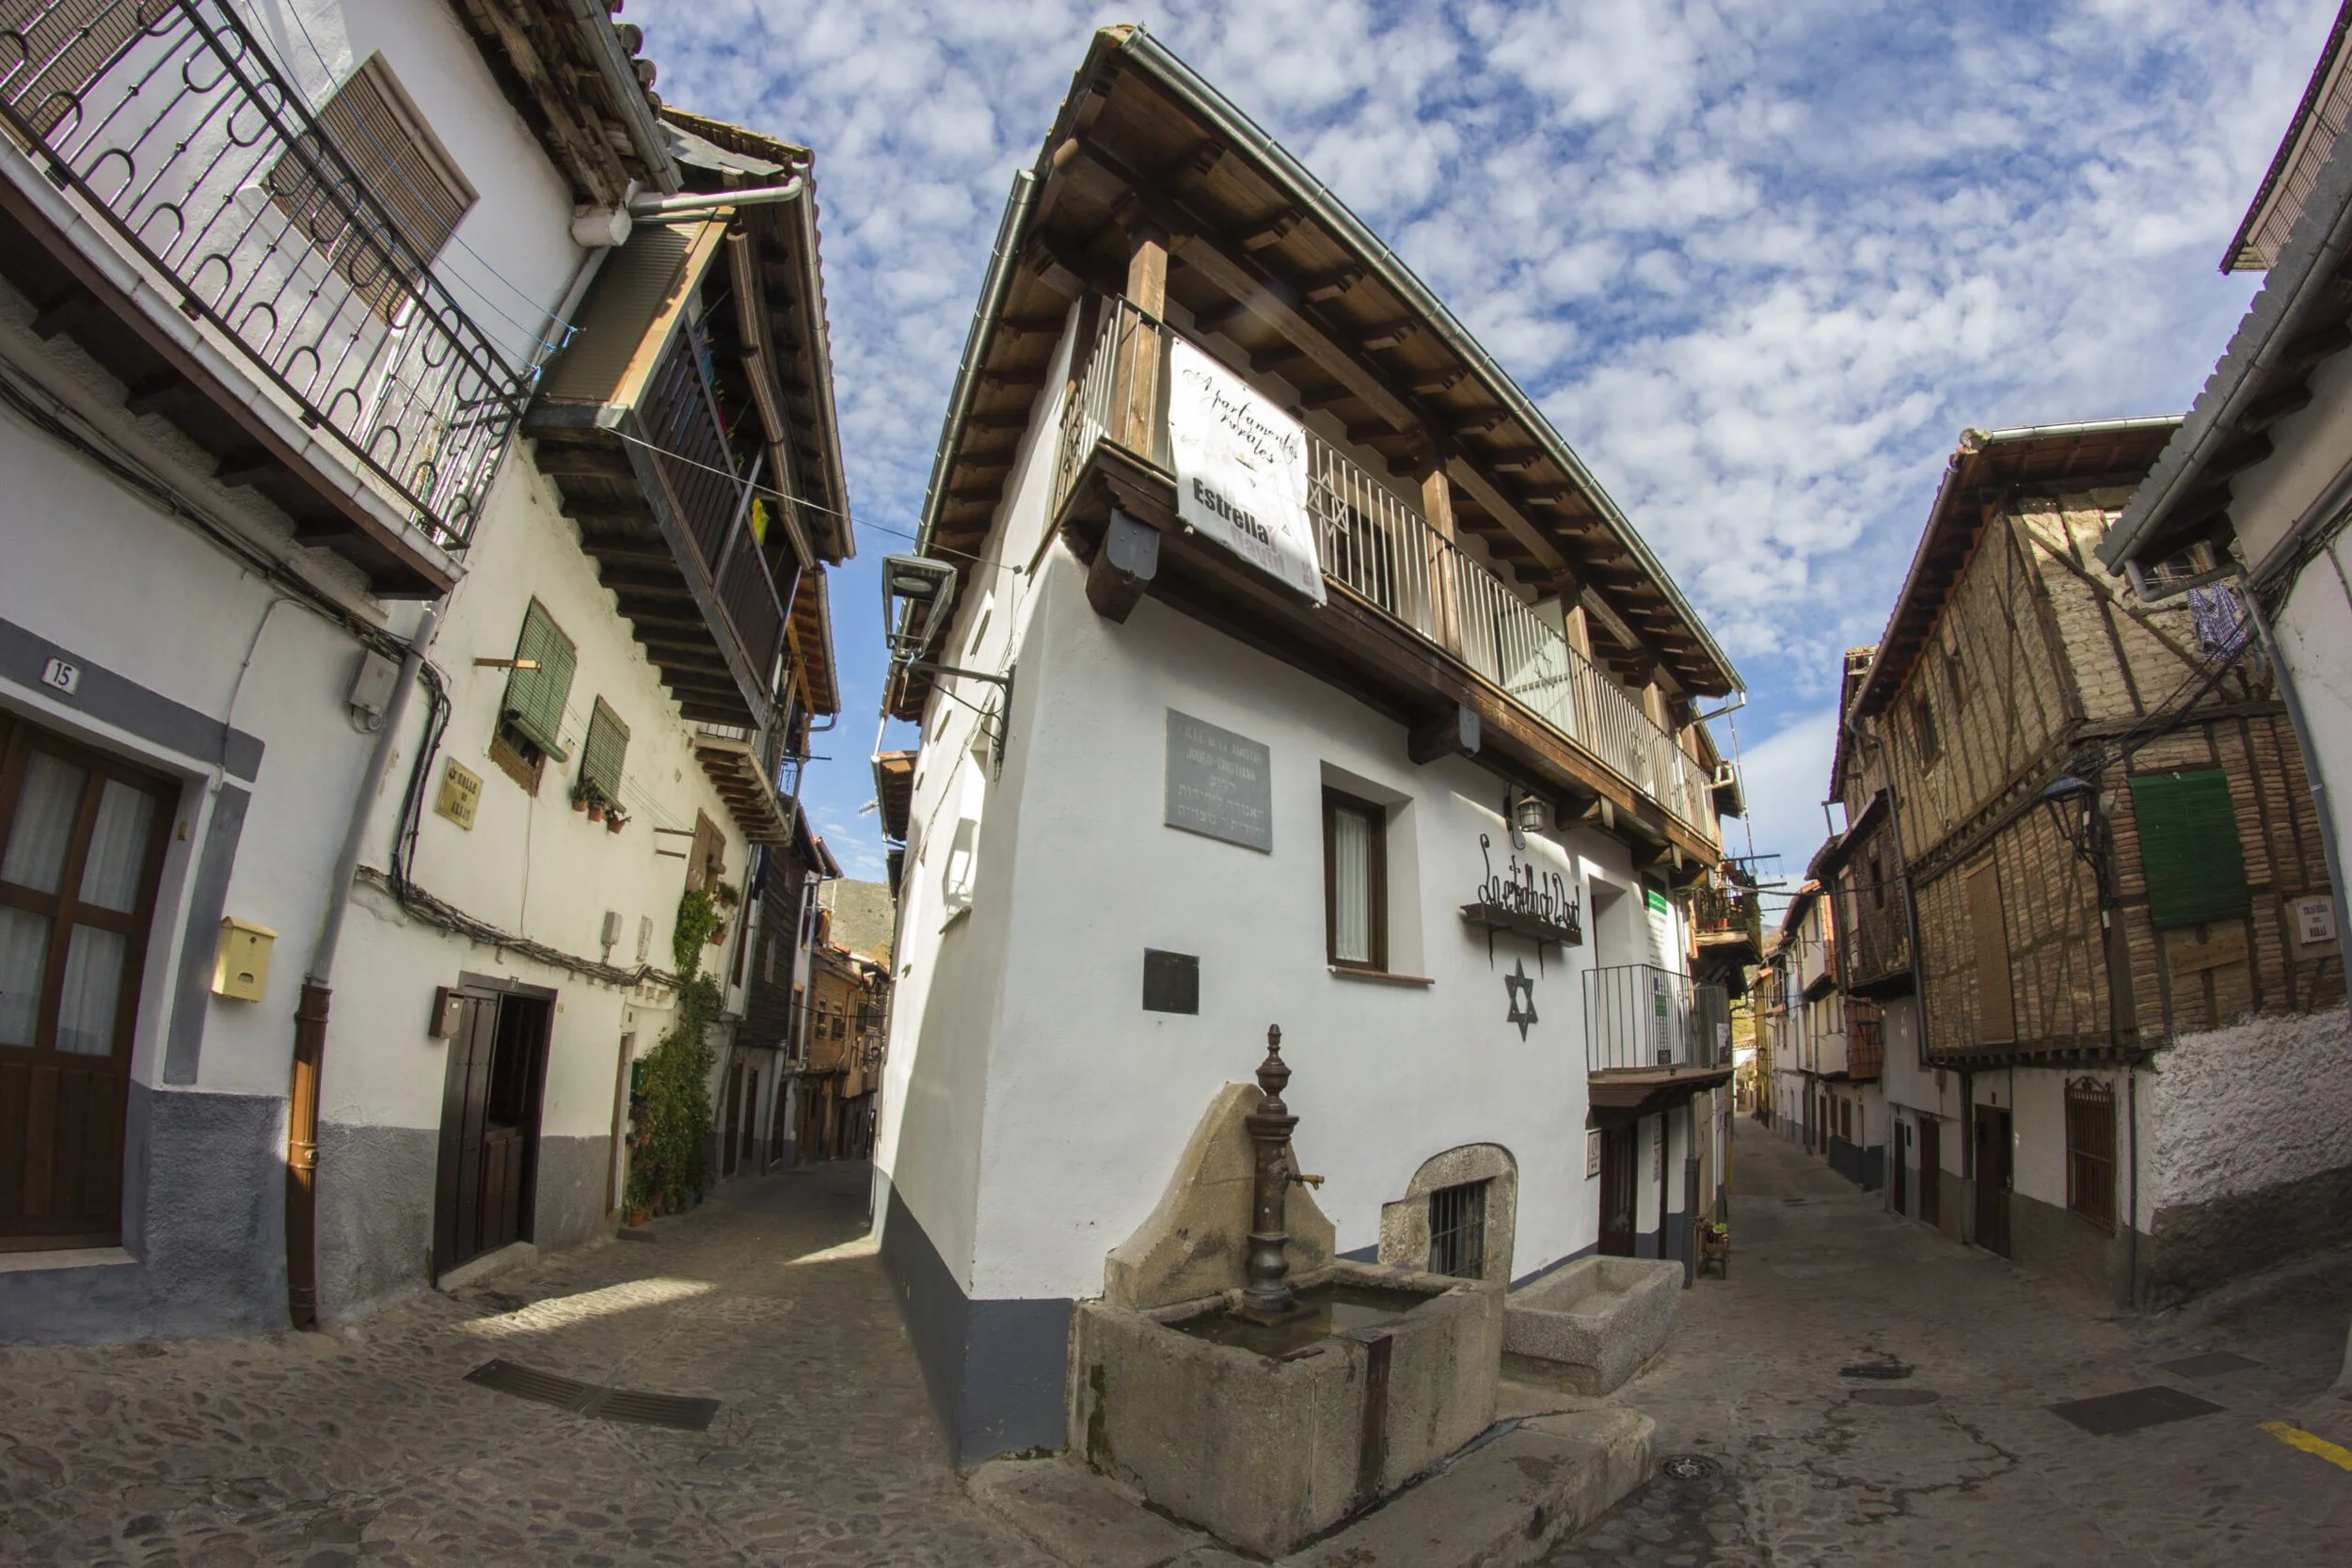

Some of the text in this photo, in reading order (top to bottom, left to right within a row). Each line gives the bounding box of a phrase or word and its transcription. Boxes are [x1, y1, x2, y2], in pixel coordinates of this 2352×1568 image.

[1183, 369, 1298, 465] Apartamentos
[1220, 413, 1274, 464] rurales
[1193, 477, 1270, 546] Estrella
[54, 661, 72, 687] 15
